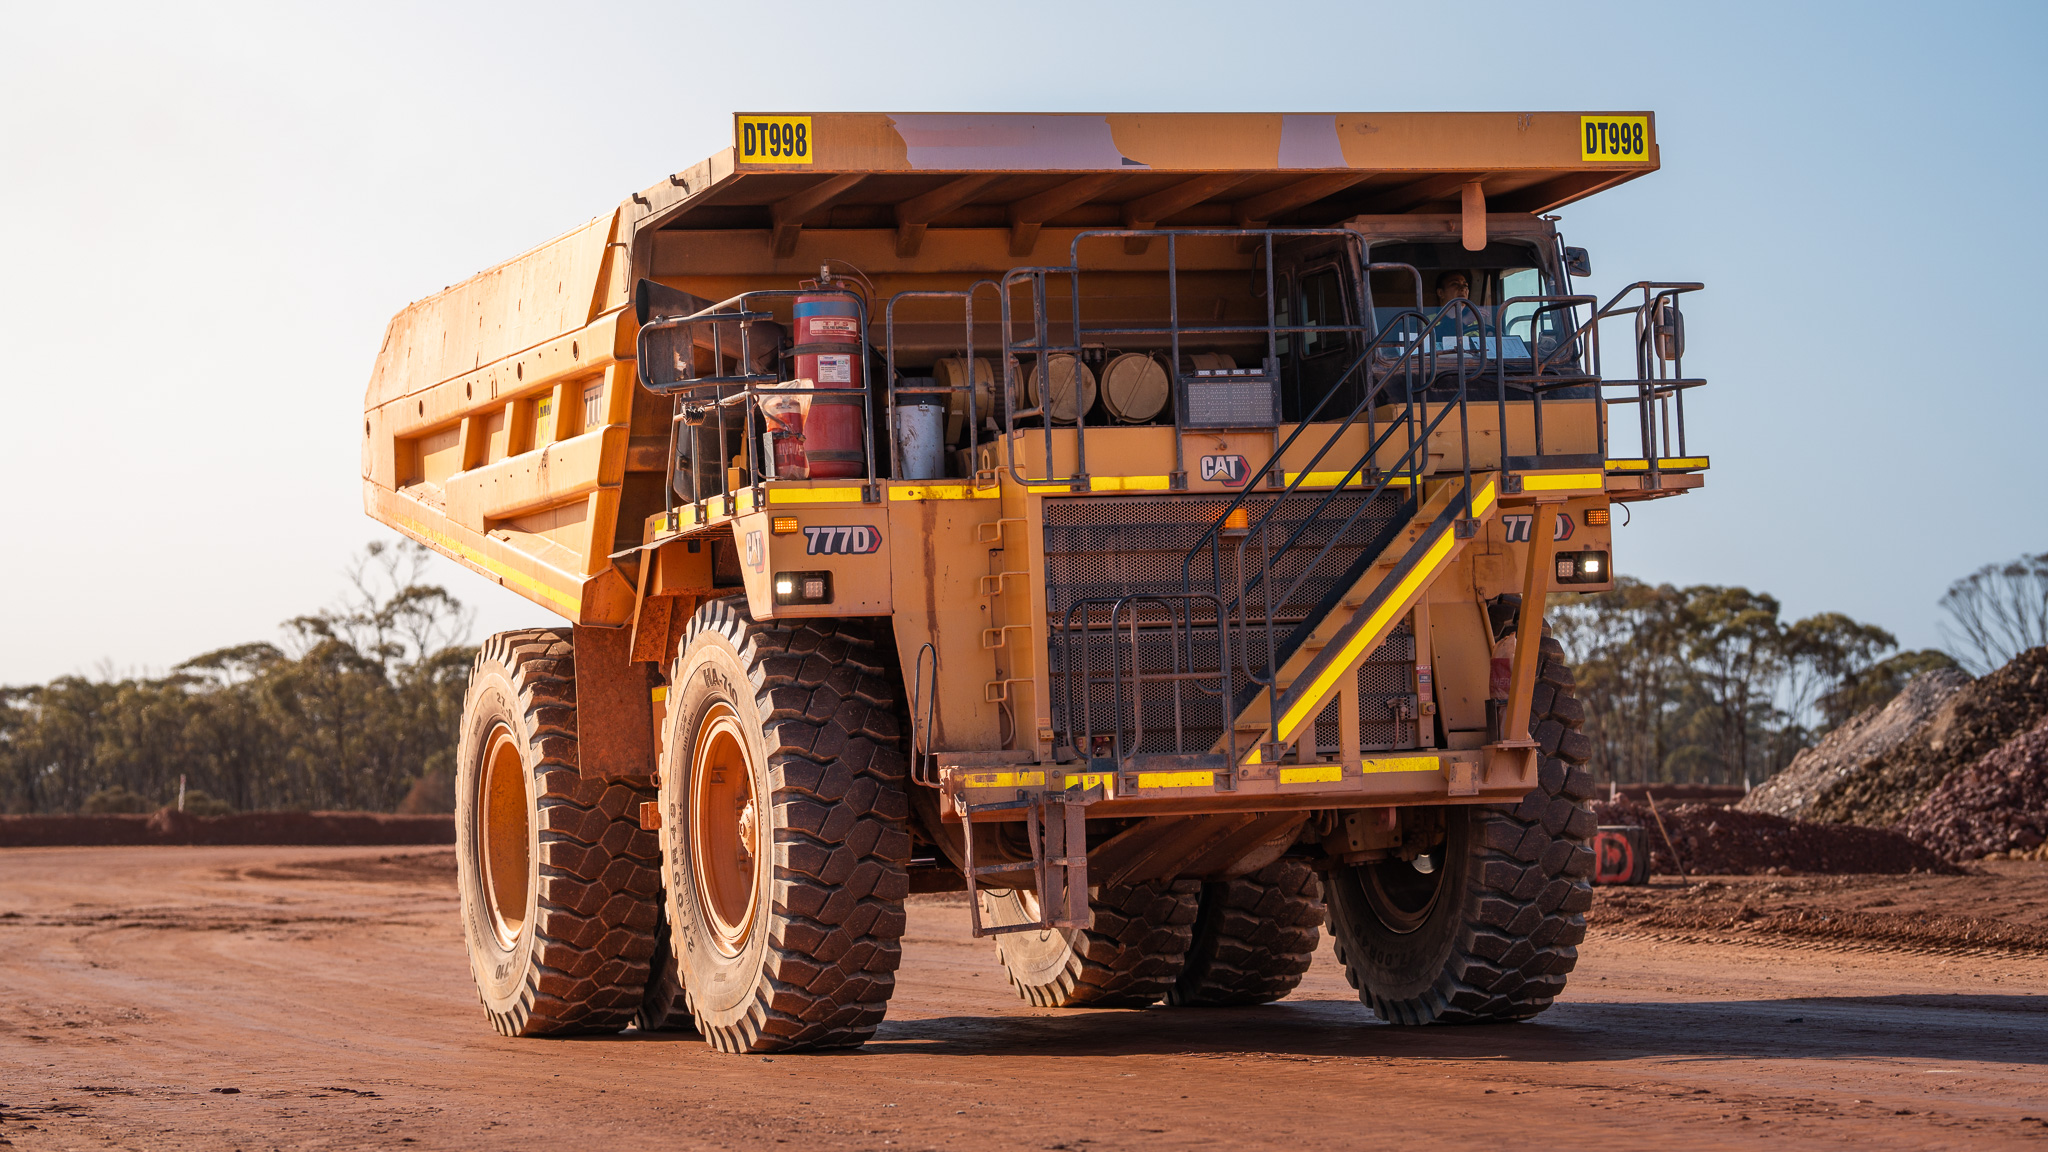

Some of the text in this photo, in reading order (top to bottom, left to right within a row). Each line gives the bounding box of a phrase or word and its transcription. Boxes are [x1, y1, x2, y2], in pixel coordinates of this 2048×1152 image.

[743, 122, 807, 157] DT998
[1585, 122, 1644, 155] DT998
[1201, 456, 1239, 480] CAT
[804, 526, 870, 553] 777D
[1503, 515, 1564, 541] 77D
[745, 530, 762, 566] CAT
[703, 667, 739, 708] HA-710
[1593, 831, 1634, 883] D
[670, 802, 695, 953] 27.00R49
